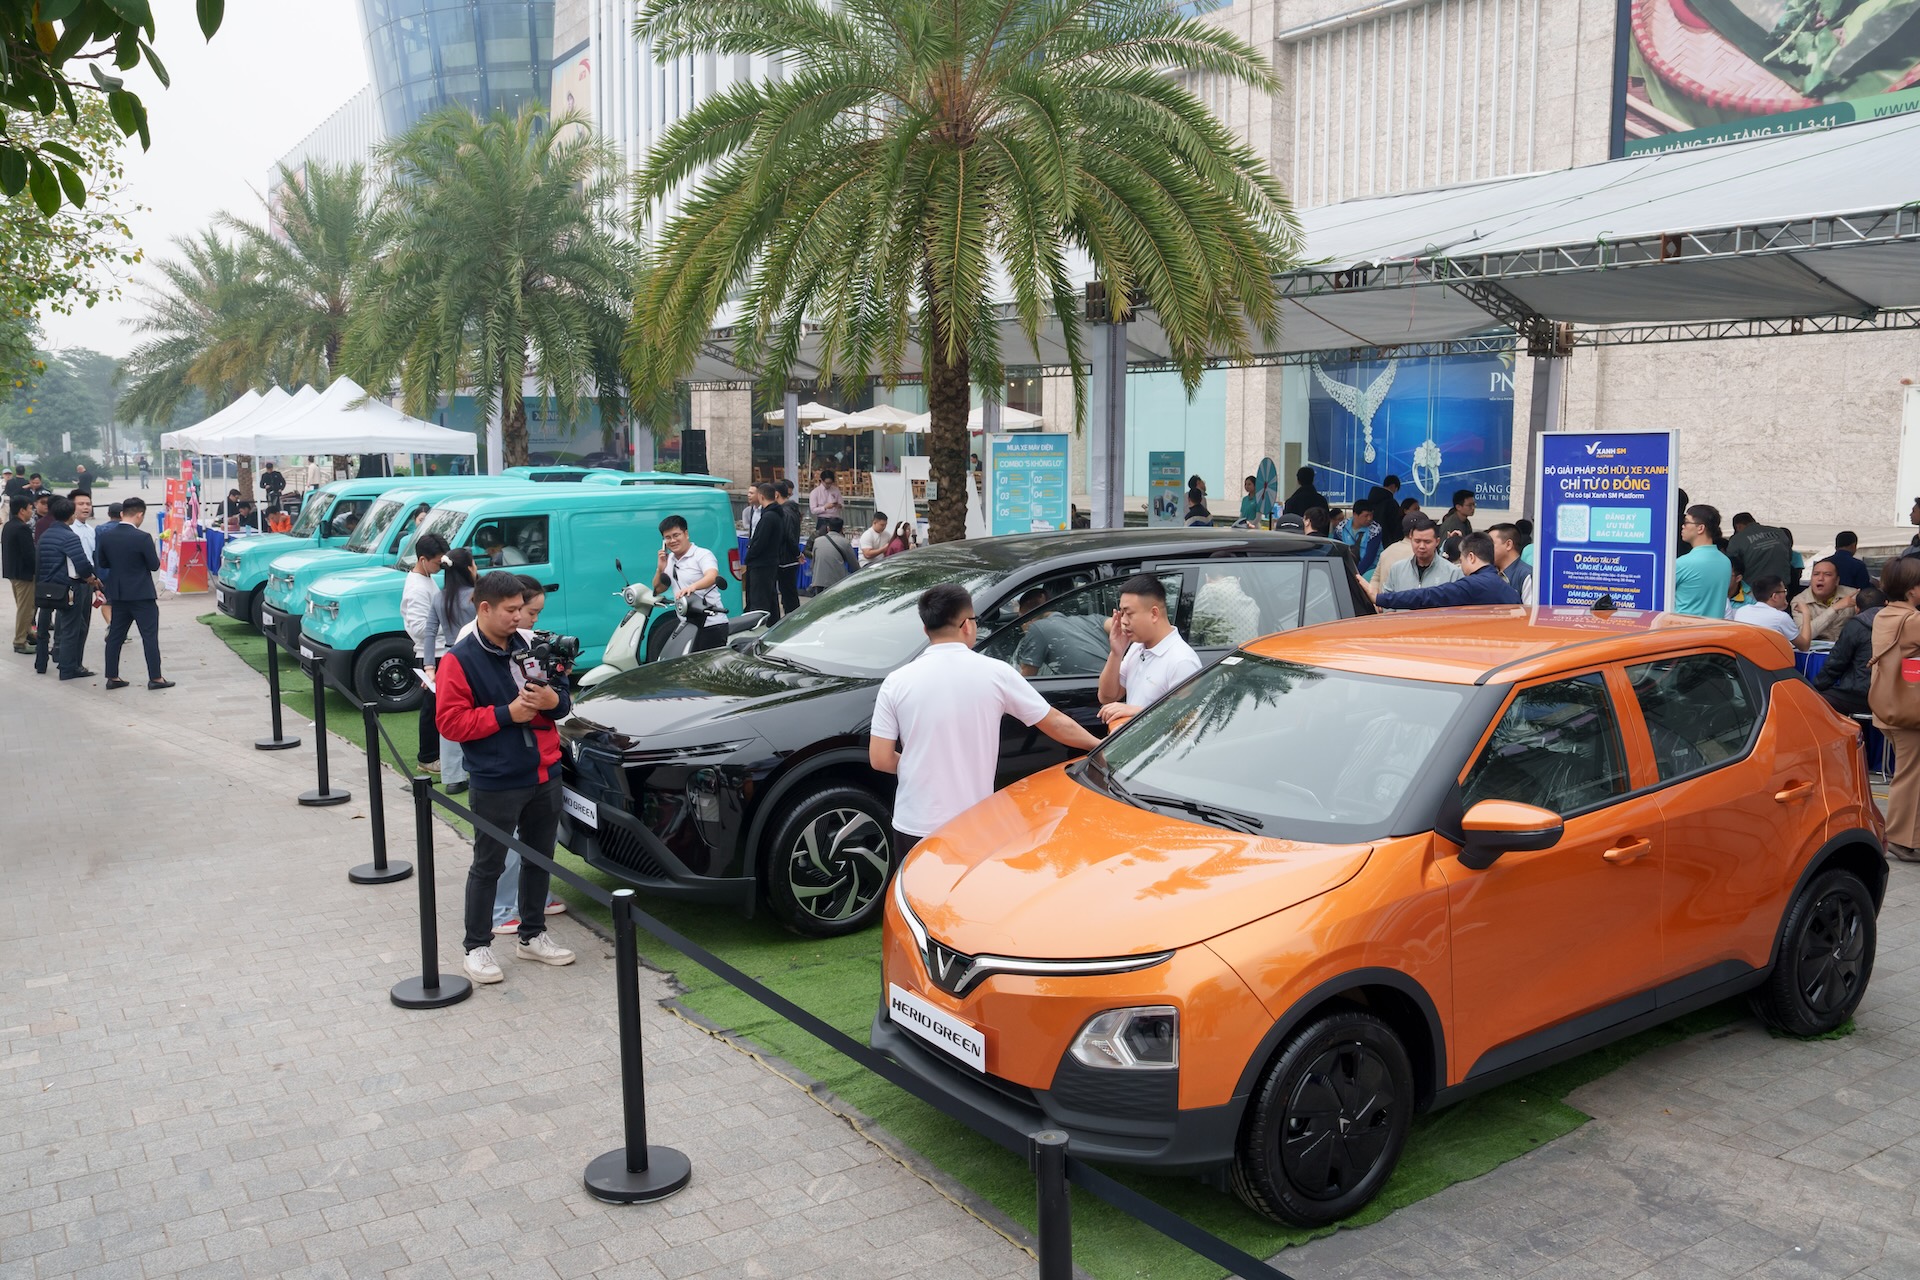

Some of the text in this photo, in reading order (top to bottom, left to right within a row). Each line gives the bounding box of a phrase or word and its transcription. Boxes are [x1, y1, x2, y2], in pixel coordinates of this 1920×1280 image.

[1490, 372, 1515, 392] PN
[1545, 465, 1556, 476] BỘ
[1574, 465, 1596, 475] PHÁP
[1631, 466, 1642, 474] XE
[1644, 466, 1669, 475] XANH
[1560, 475, 1651, 491] CHỈ TỪ 0 ĐỒNG
[892, 997, 981, 1058] HERIO GREEN
